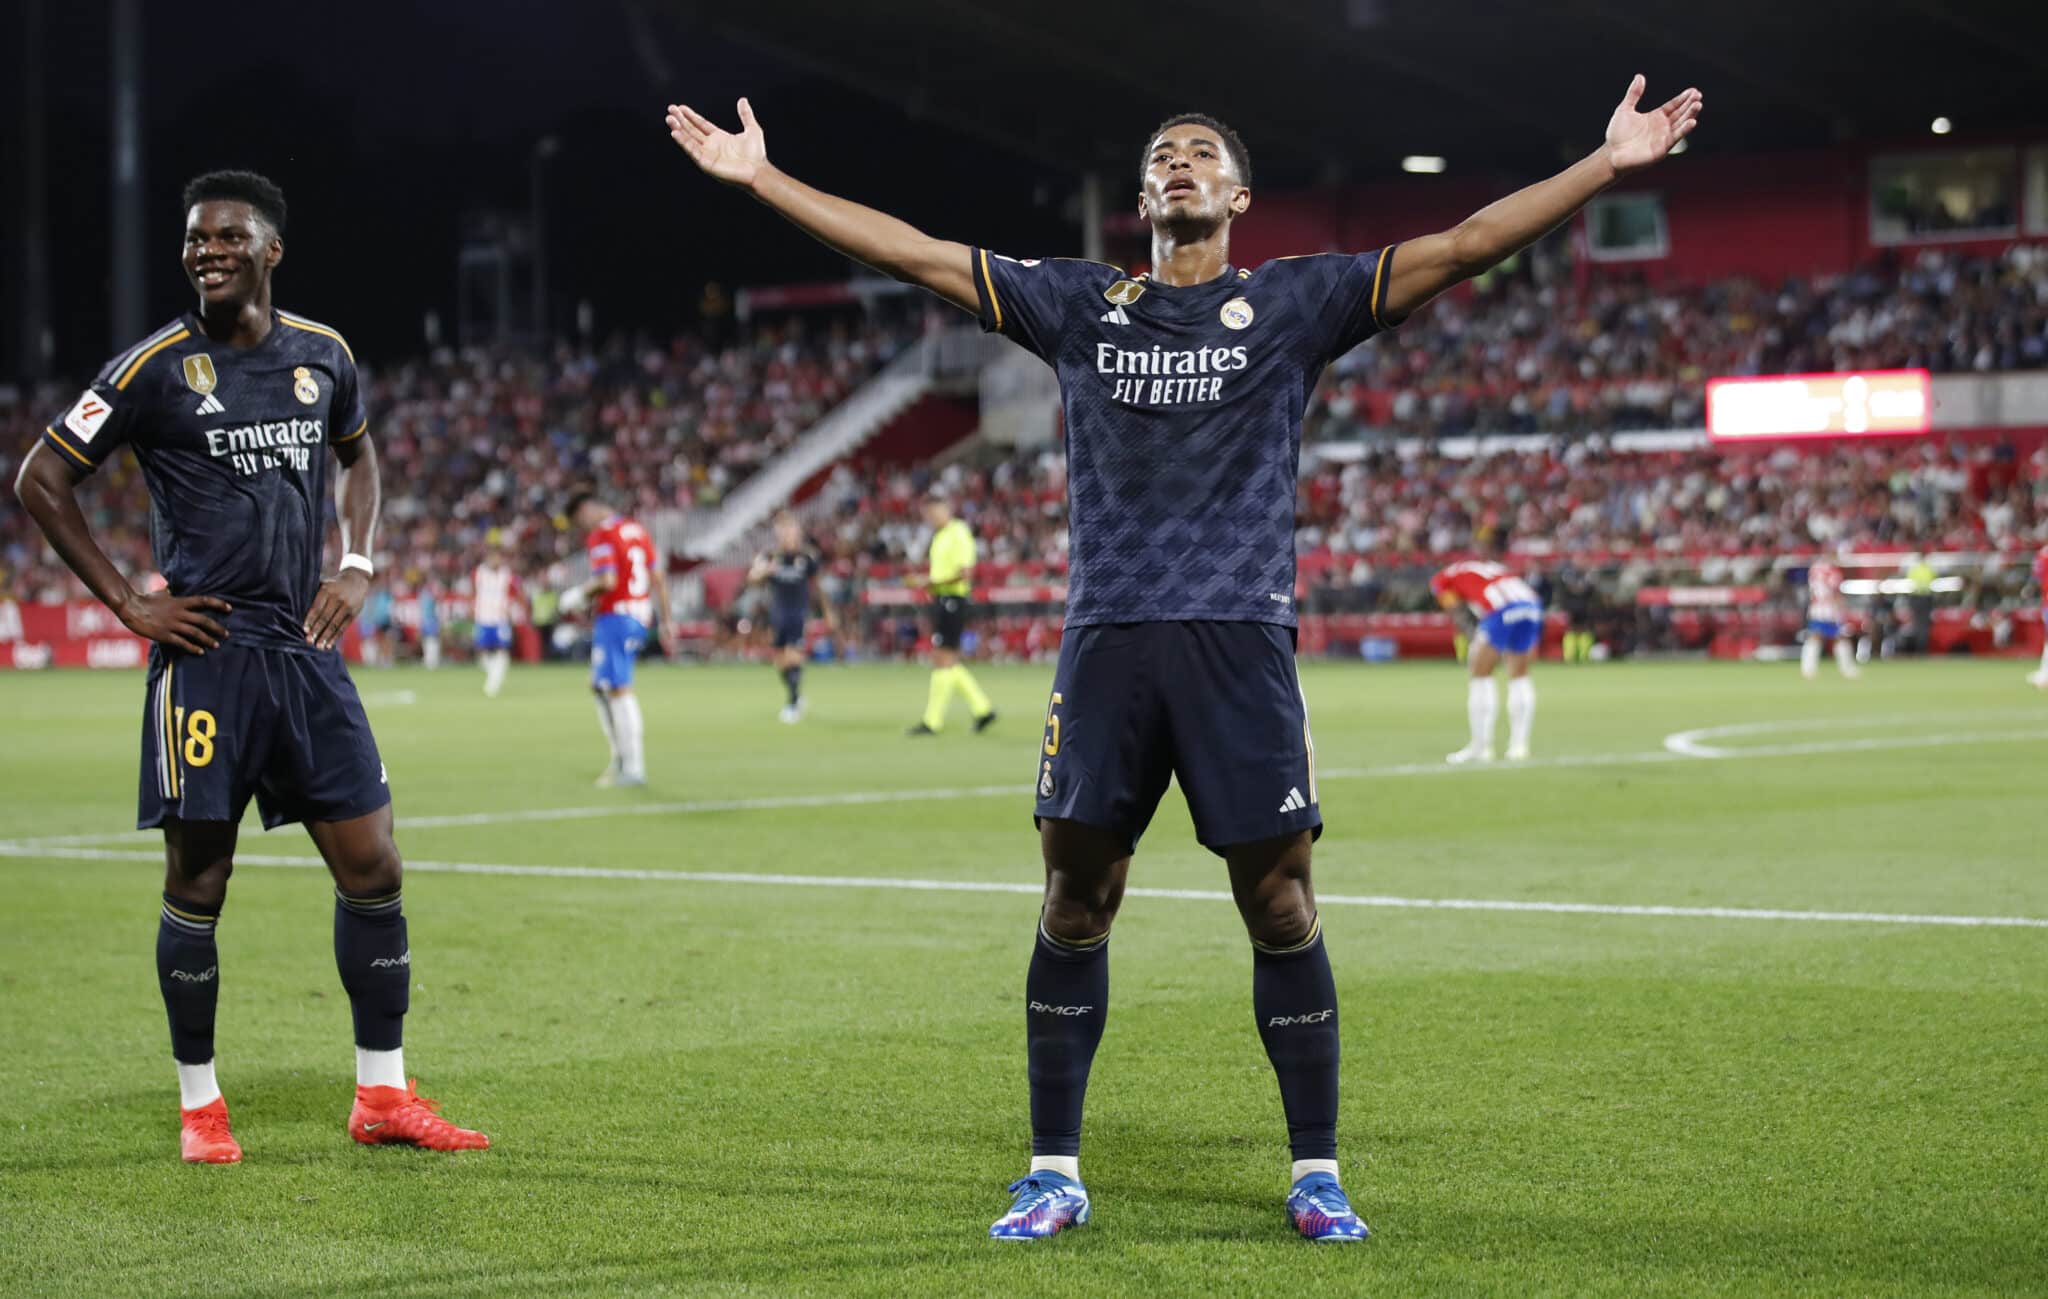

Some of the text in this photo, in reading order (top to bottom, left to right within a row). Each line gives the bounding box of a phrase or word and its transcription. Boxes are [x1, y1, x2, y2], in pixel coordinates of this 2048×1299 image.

[1096, 343, 1248, 375] Emirates
[1112, 377, 1223, 404] FLY BETTER
[205, 417, 322, 457] Emirates
[232, 452, 258, 476] FLY
[627, 545, 649, 597] 3
[175, 706, 216, 766] 18
[1029, 1000, 1093, 1016] RMCF
[1269, 1009, 1333, 1027] RMCF
